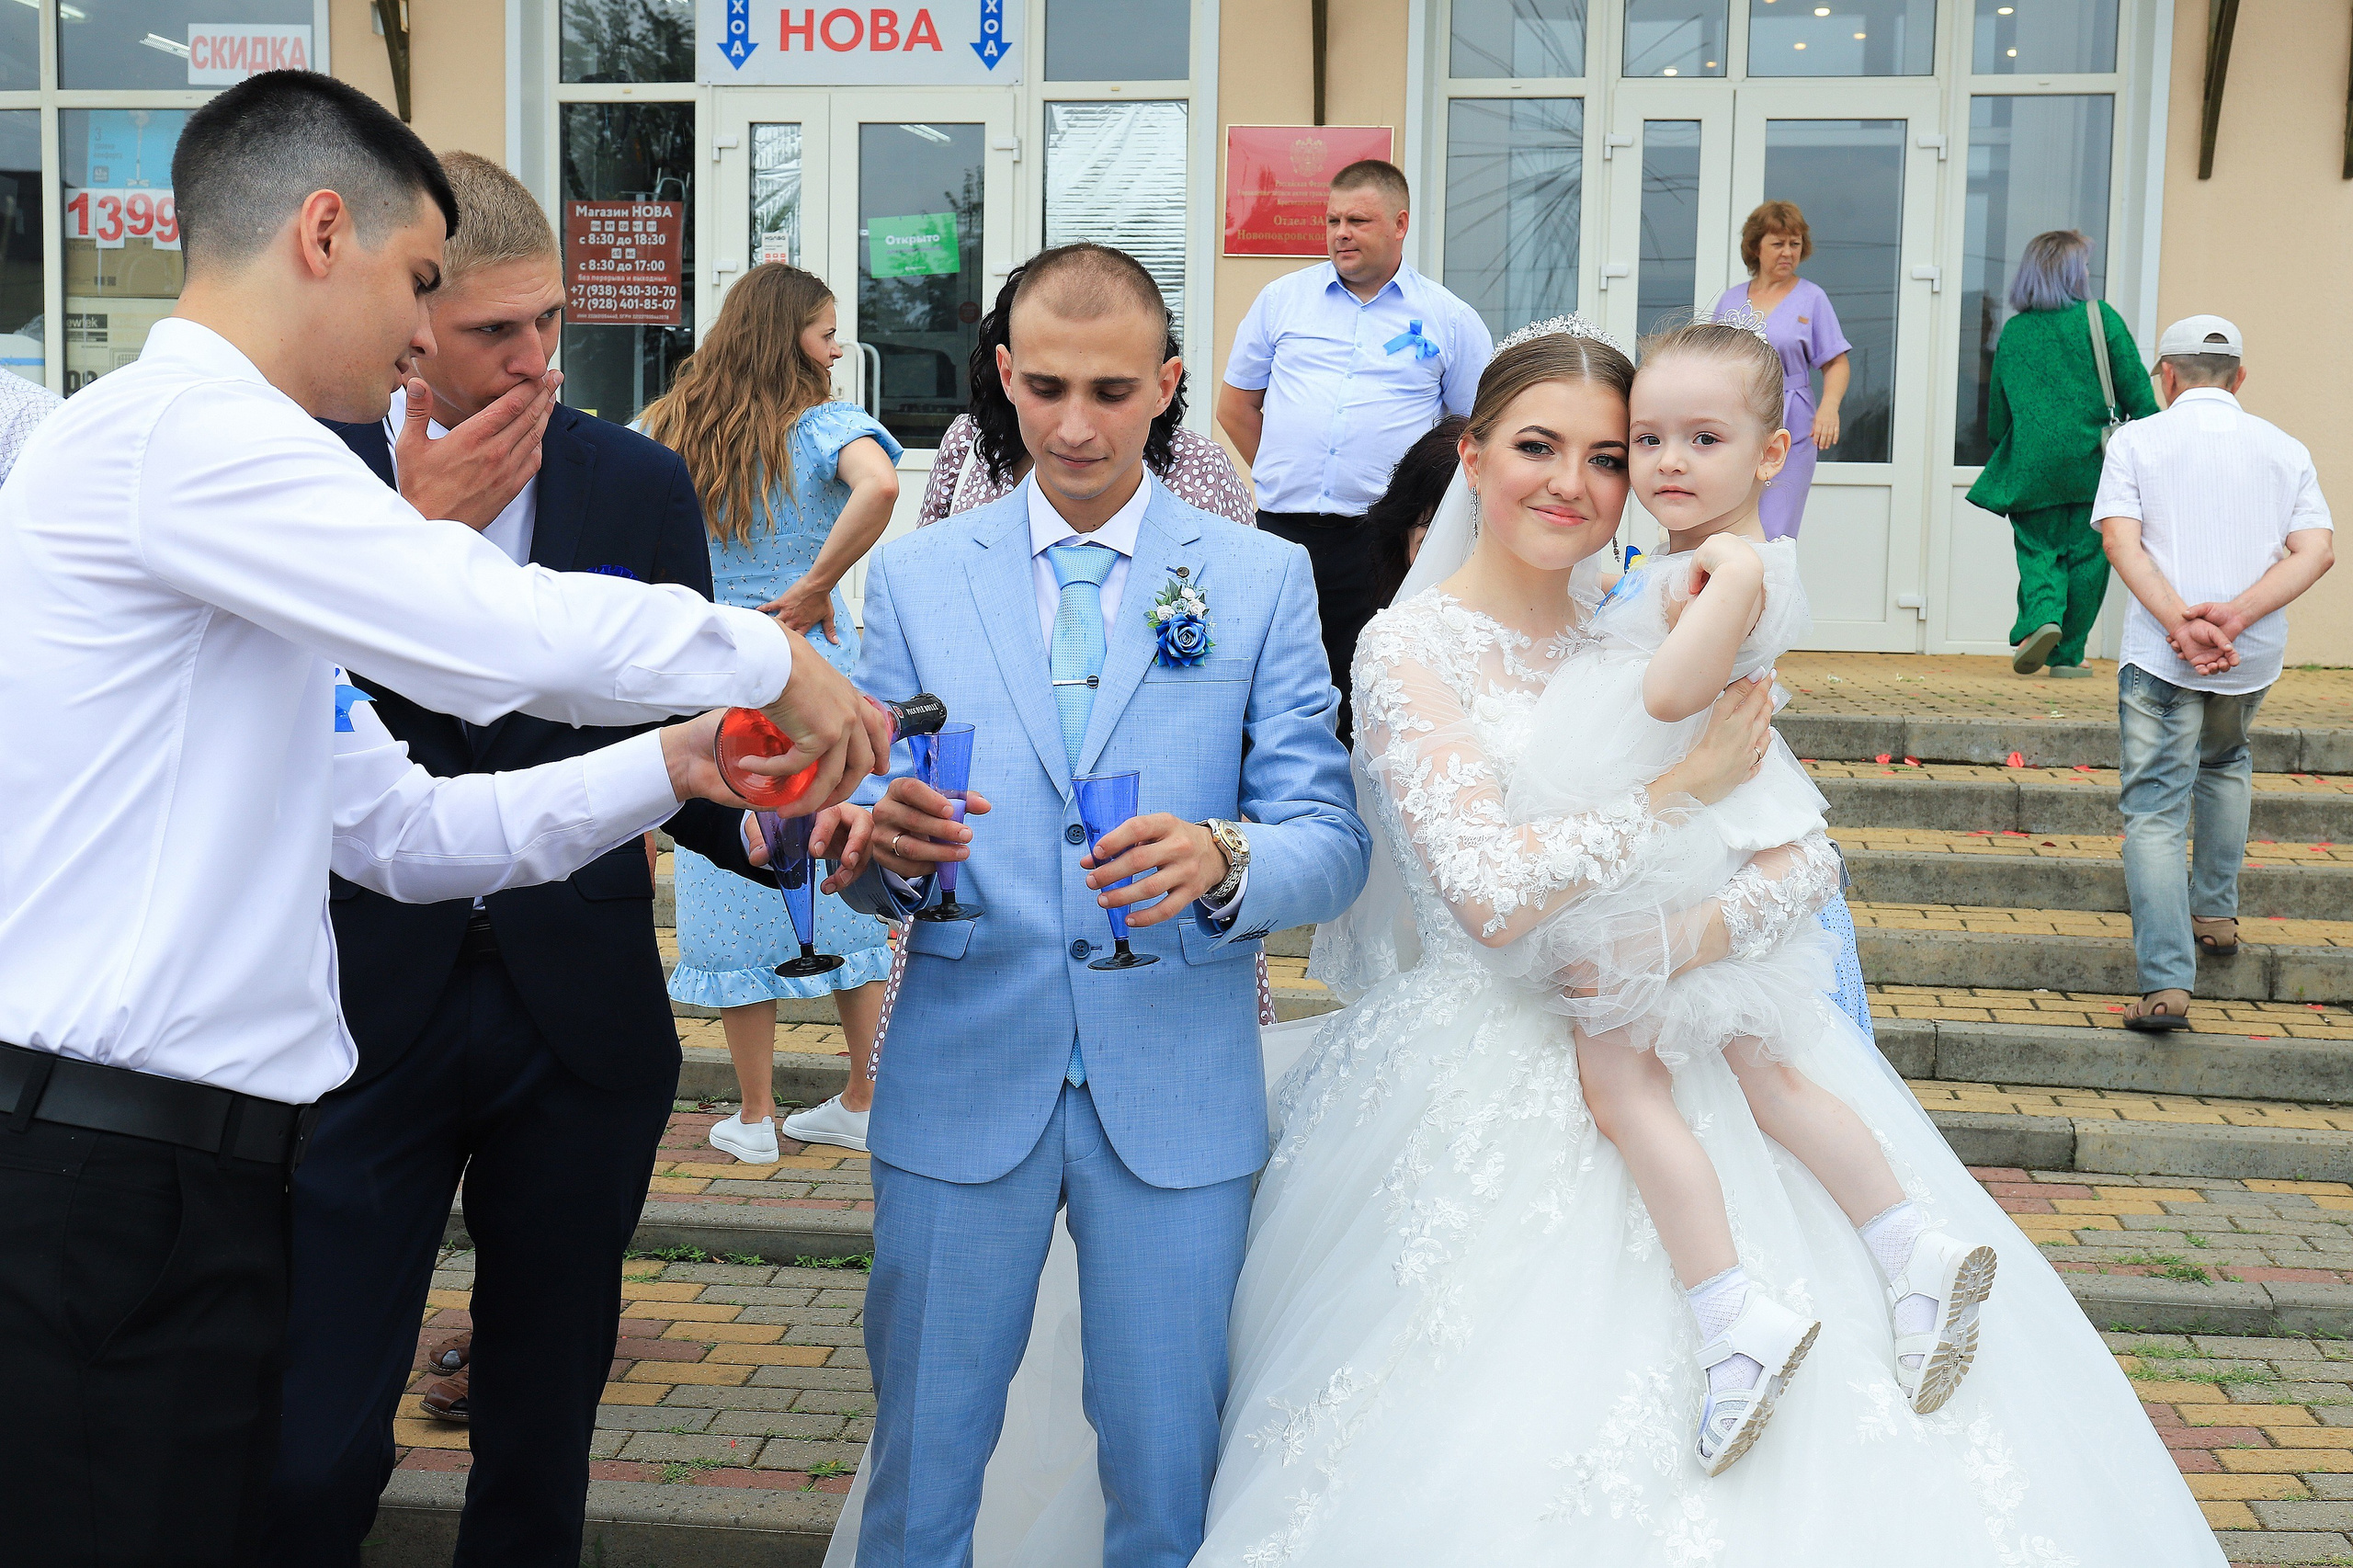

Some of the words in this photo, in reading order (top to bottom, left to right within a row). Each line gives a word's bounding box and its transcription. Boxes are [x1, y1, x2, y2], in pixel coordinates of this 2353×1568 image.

[730, 0, 746, 57] ХОД
[779, 8, 943, 51] НОВА
[983, 0, 999, 57] ХОД
[191, 35, 308, 75] СКИДКА
[68, 192, 179, 243] 1399
[575, 205, 629, 217] Магазин
[632, 205, 673, 217] НОВА
[1273, 215, 1306, 226] Отдел
[1310, 215, 1326, 226] ЗА
[588, 233, 615, 244] 8:30
[616, 237, 631, 246] до
[634, 233, 666, 245] 18:30
[885, 234, 940, 245] Открыто
[1237, 229, 1326, 243] Новопокровског
[588, 259, 615, 271] 8:30
[617, 263, 632, 272] до
[634, 260, 665, 271] 17:00
[570, 284, 585, 295] +7
[586, 284, 617, 298] (938)
[619, 285, 676, 296] 430-30-70
[571, 298, 585, 309] +7
[587, 298, 618, 311] (928)
[620, 299, 676, 311] 401-85-07
[67, 316, 97, 327] ewtek
